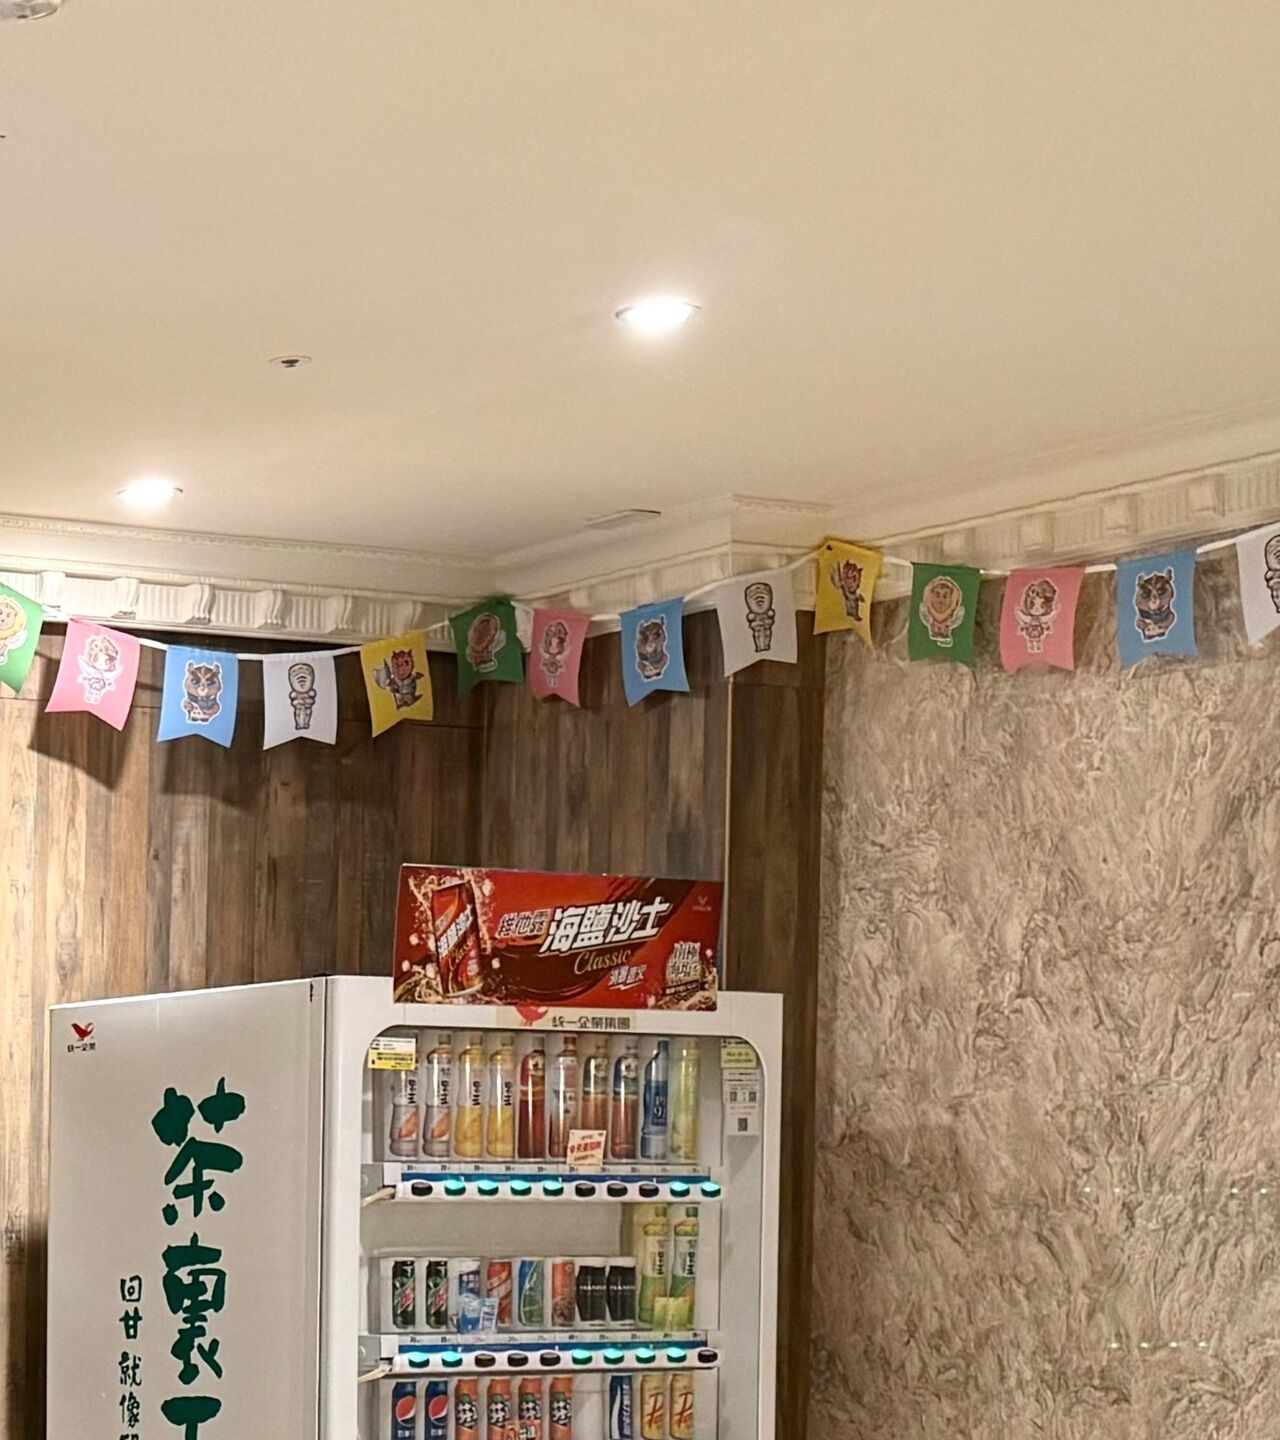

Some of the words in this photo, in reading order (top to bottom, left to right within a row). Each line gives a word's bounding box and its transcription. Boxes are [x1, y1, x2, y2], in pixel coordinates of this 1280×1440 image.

[539, 895, 673, 954] 海鹽沙士
[573, 948, 633, 976] Classic
